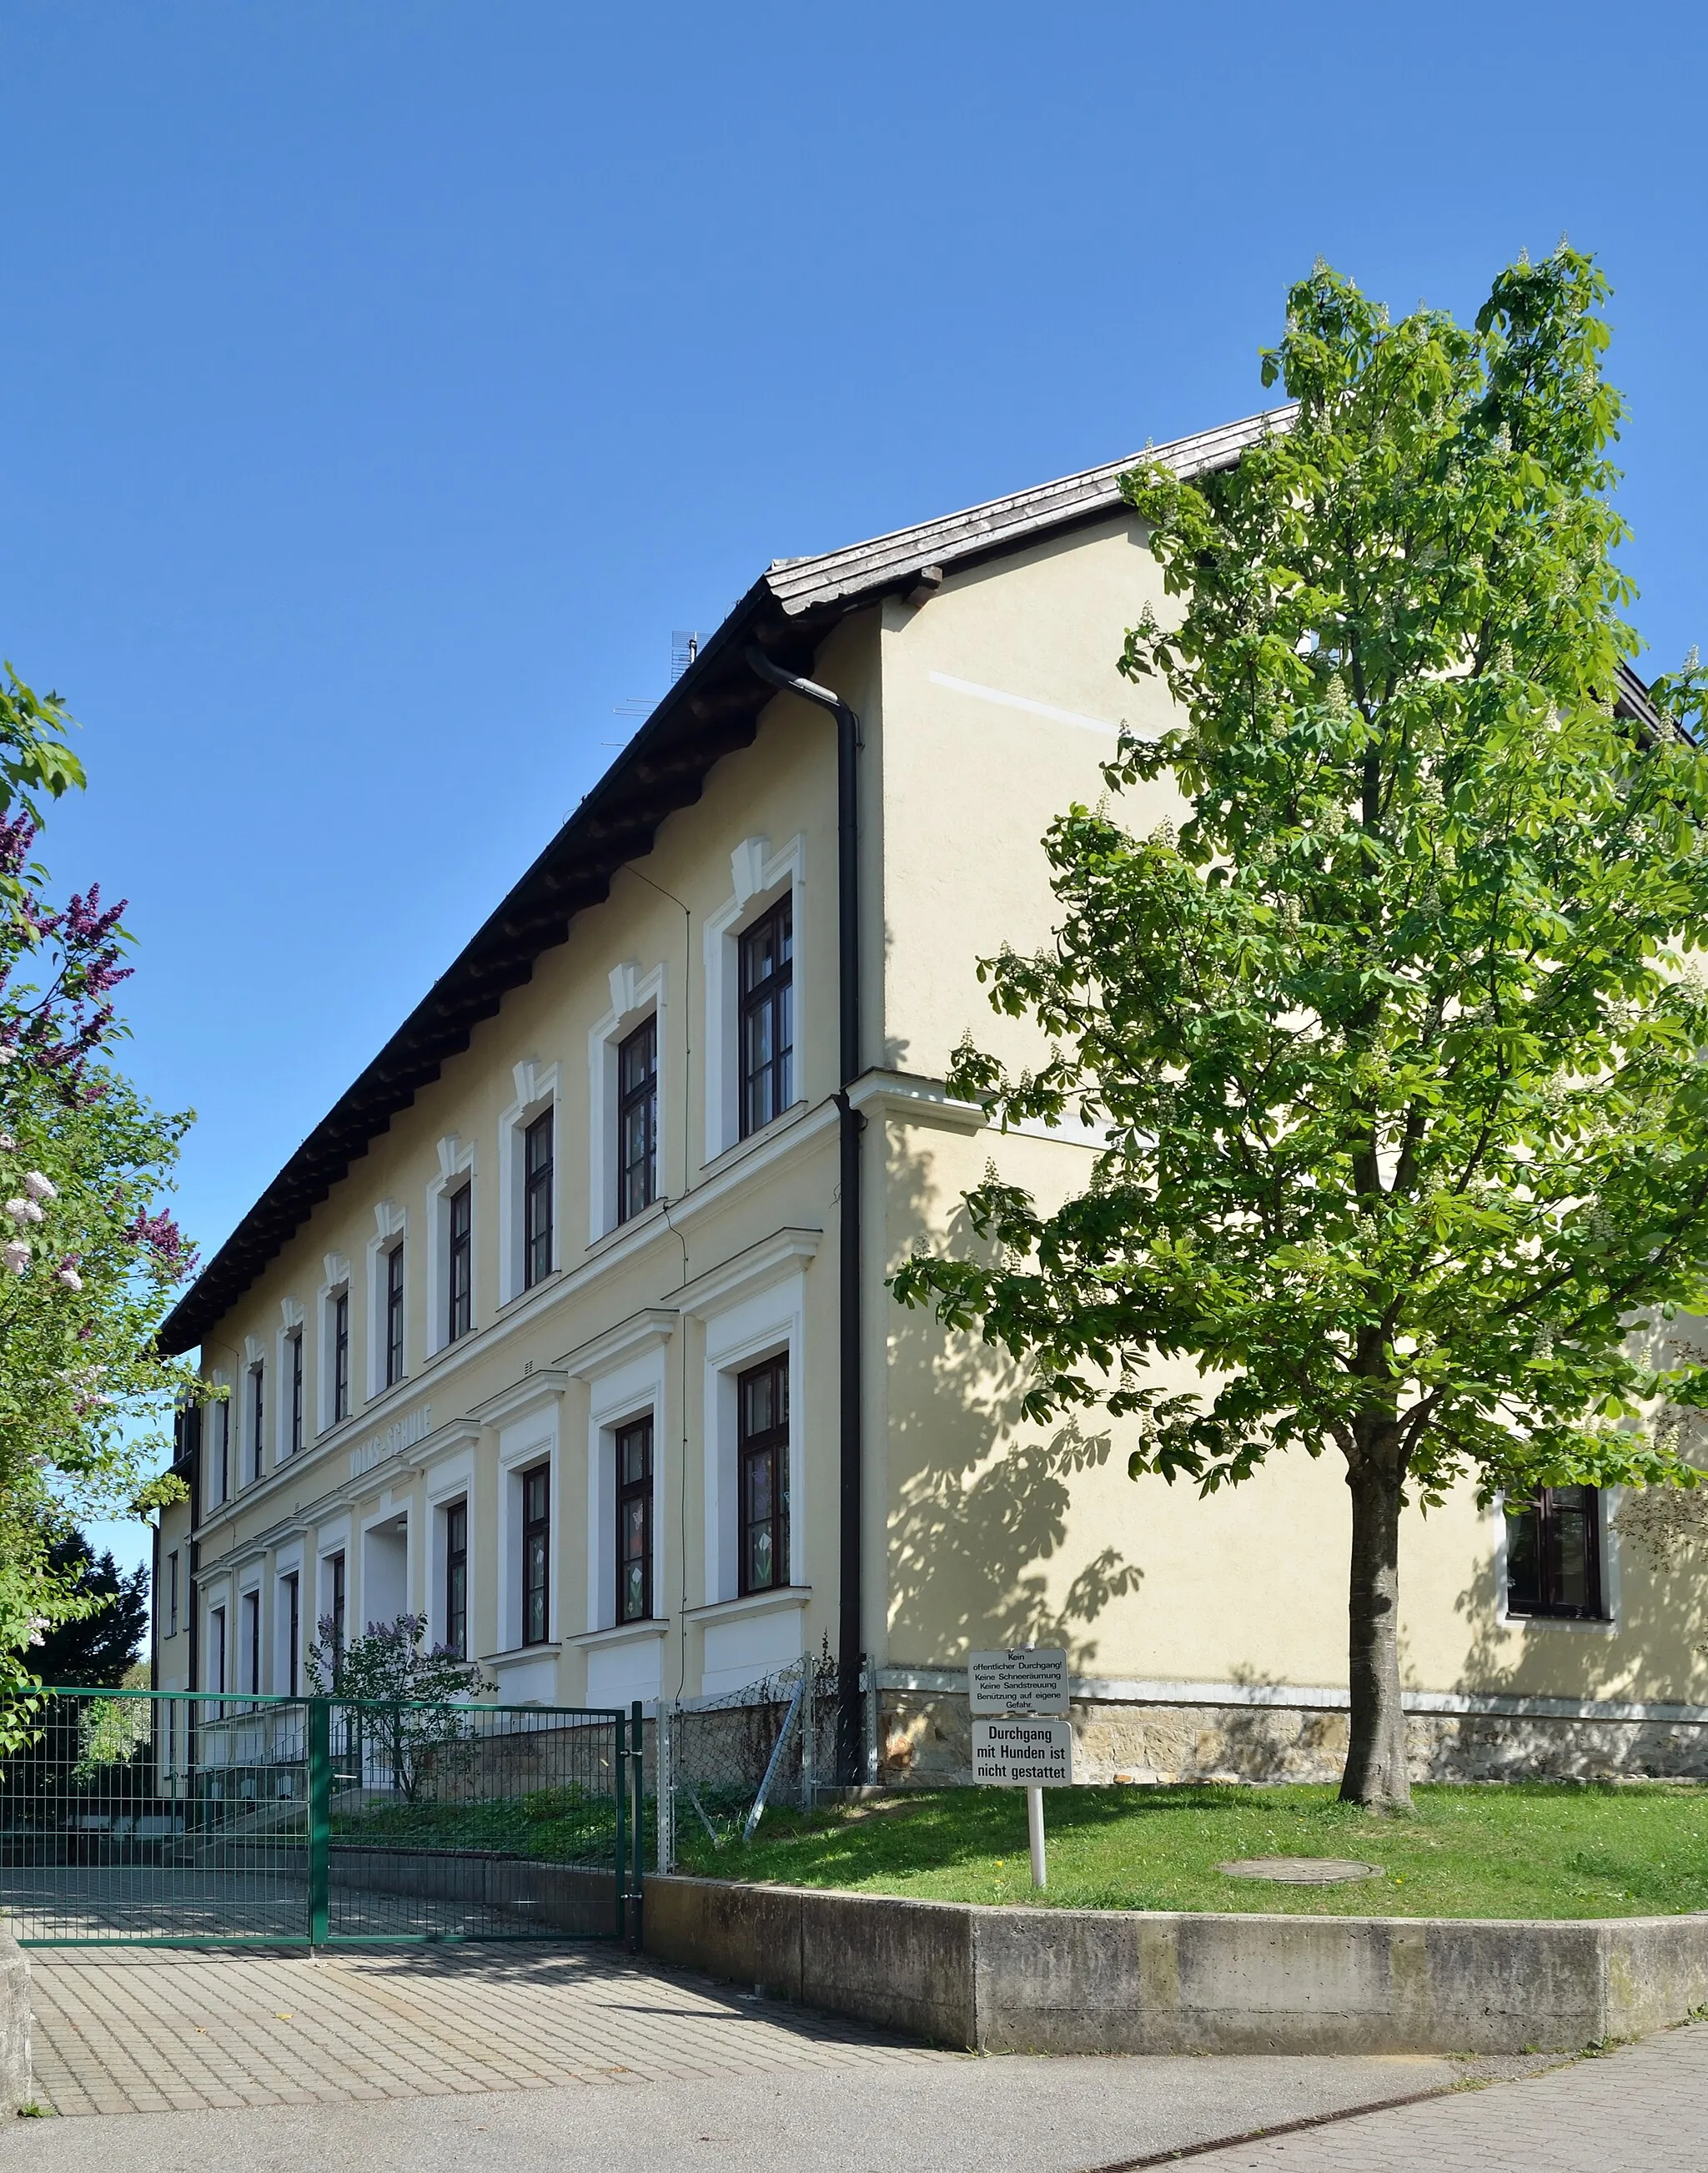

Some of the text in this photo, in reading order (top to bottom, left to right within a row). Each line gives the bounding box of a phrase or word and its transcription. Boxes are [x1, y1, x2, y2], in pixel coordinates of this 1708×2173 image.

[973, 1662, 1062, 1671] öffentlicher Durchgang!
[998, 1673, 1061, 1681] Schneeräumung
[1003, 1682, 1057, 1690] Sandstreuung
[977, 1693, 1017, 1701] Benützung
[988, 1726, 1052, 1743] Durchgang
[977, 1745, 1066, 1760] mit Hunden ist
[977, 1763, 1066, 1780] nicht gestattet
